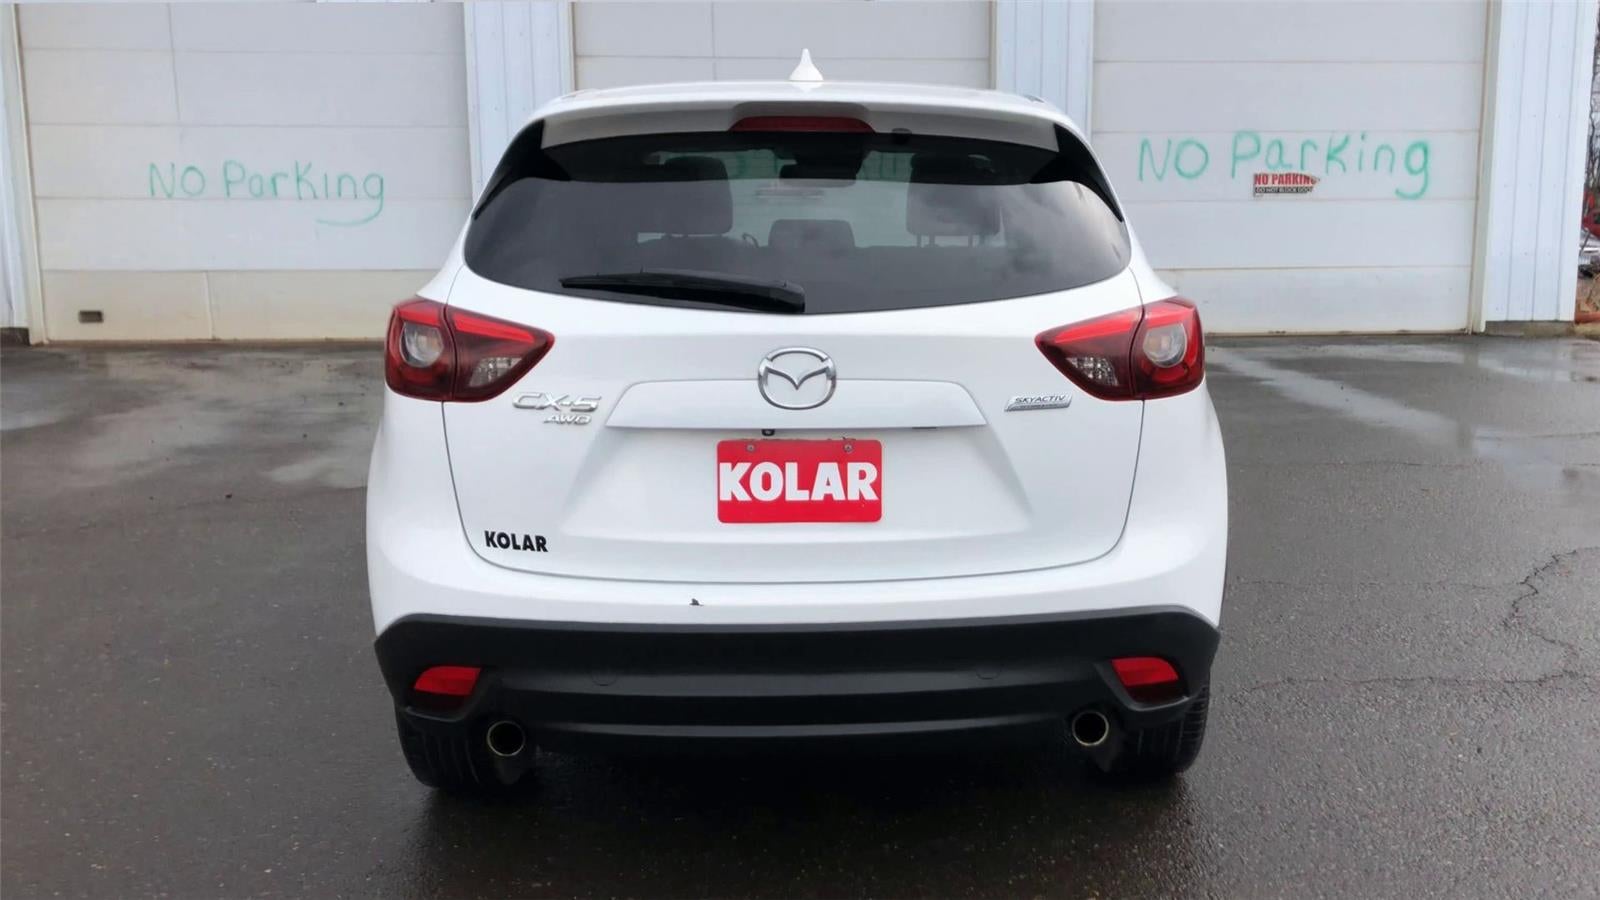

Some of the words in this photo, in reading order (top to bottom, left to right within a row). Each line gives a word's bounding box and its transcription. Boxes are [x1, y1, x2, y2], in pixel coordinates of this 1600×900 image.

[1255, 173, 1269, 185] NO
[512, 392, 602, 412] CX-5
[1014, 395, 1066, 404] SKYACTIV
[543, 414, 591, 425] AWD
[719, 462, 879, 501] KOLAR
[484, 530, 548, 552] KOLAR
